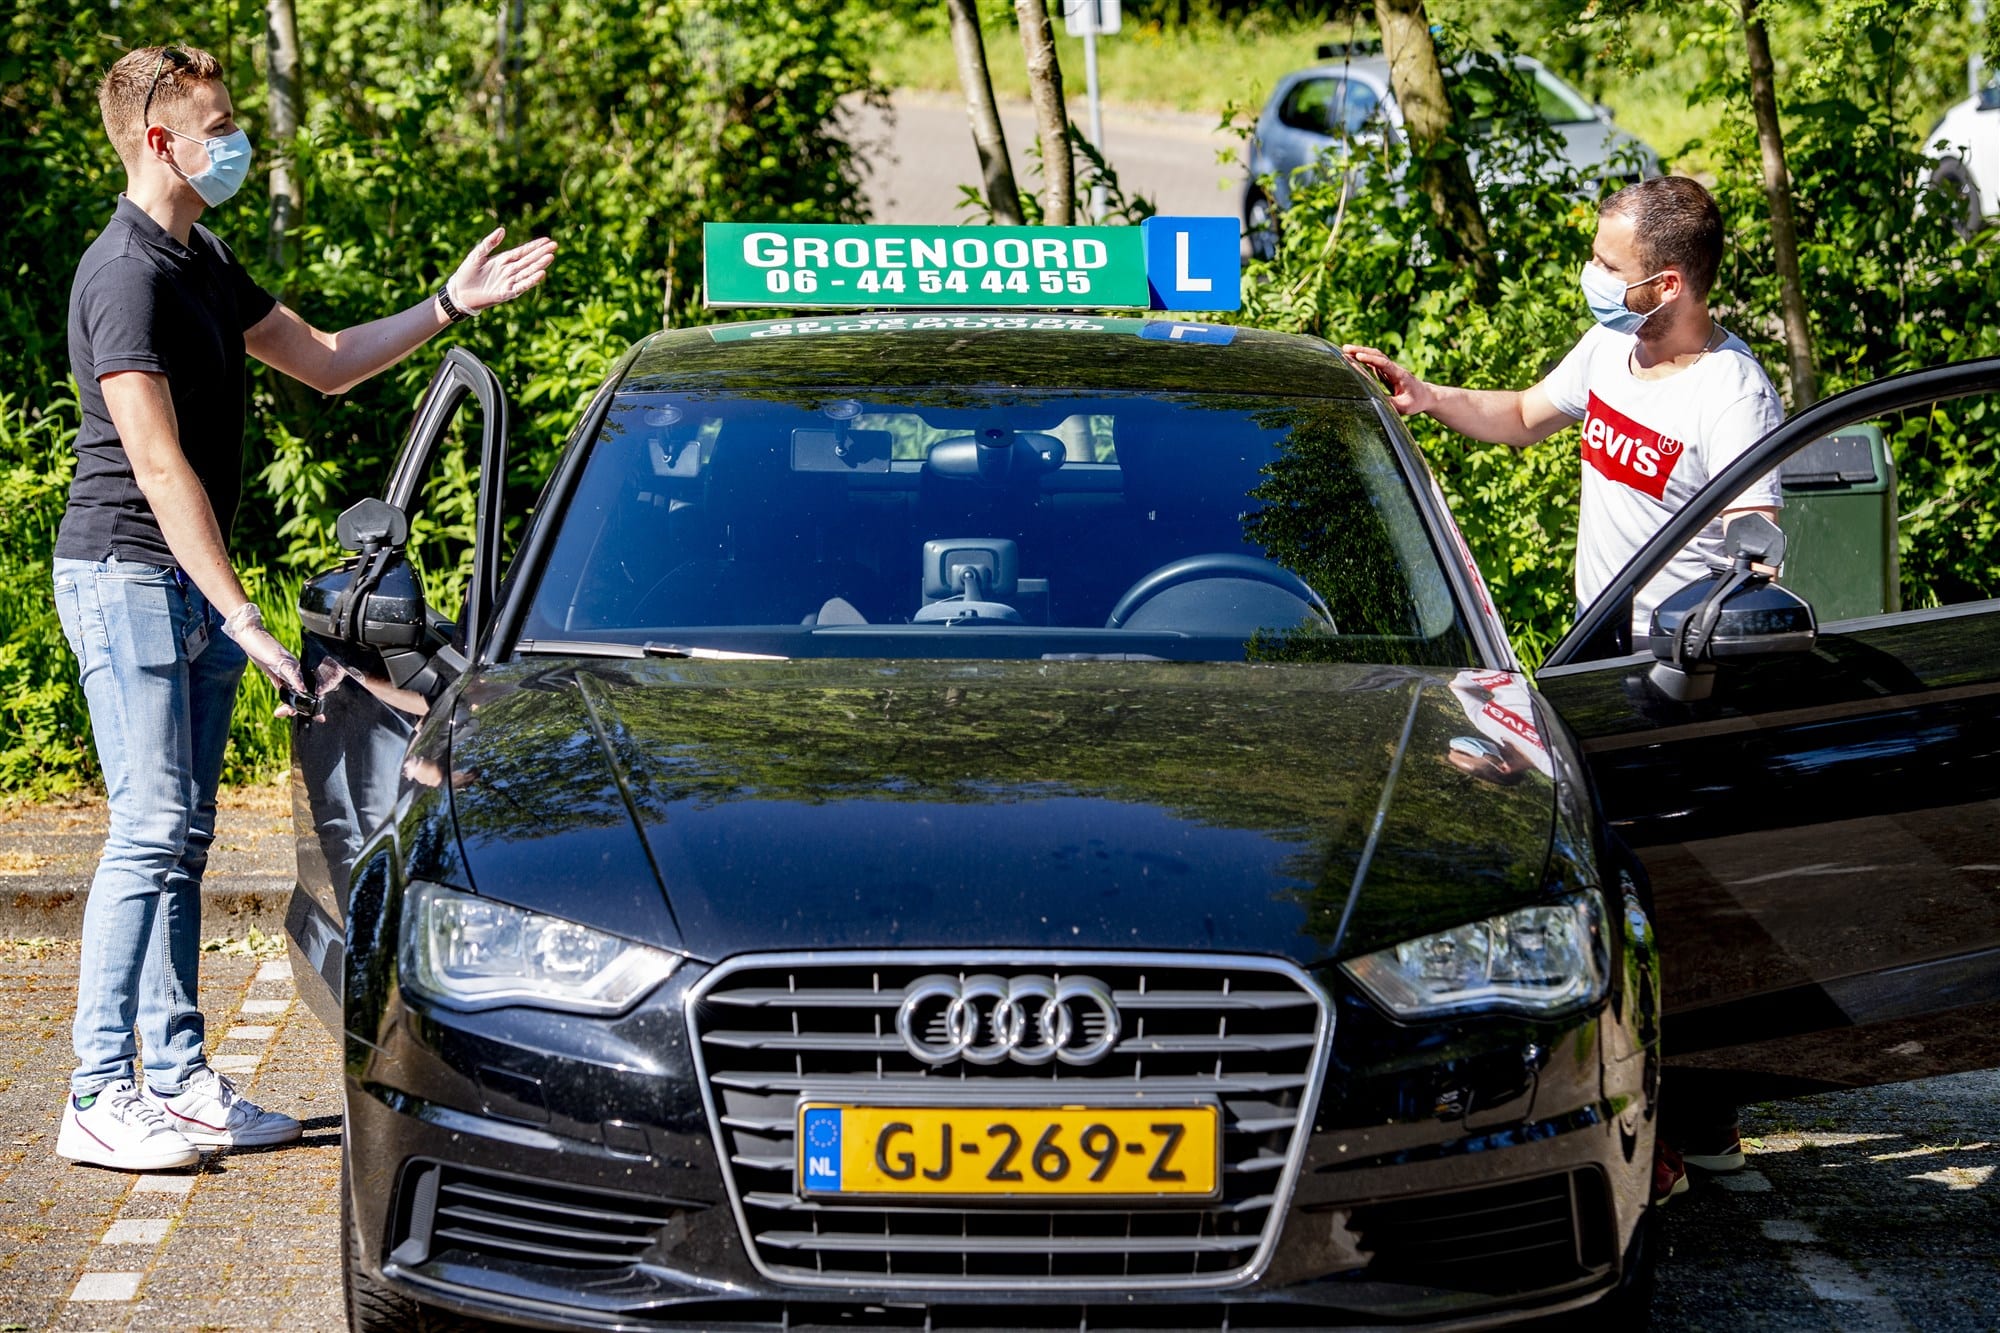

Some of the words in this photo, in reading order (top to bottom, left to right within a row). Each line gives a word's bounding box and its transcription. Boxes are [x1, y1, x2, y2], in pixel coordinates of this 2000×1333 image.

[743, 232, 1108, 268] GROENOORD
[1175, 231, 1212, 292] L
[766, 270, 818, 293] 06
[857, 271, 906, 293] 44
[918, 271, 969, 293] 54
[980, 271, 1030, 293] 44
[1039, 271, 1091, 294] 55
[809, 1157, 836, 1176] NL
[875, 1122, 1187, 1181] GJ-269-Z
